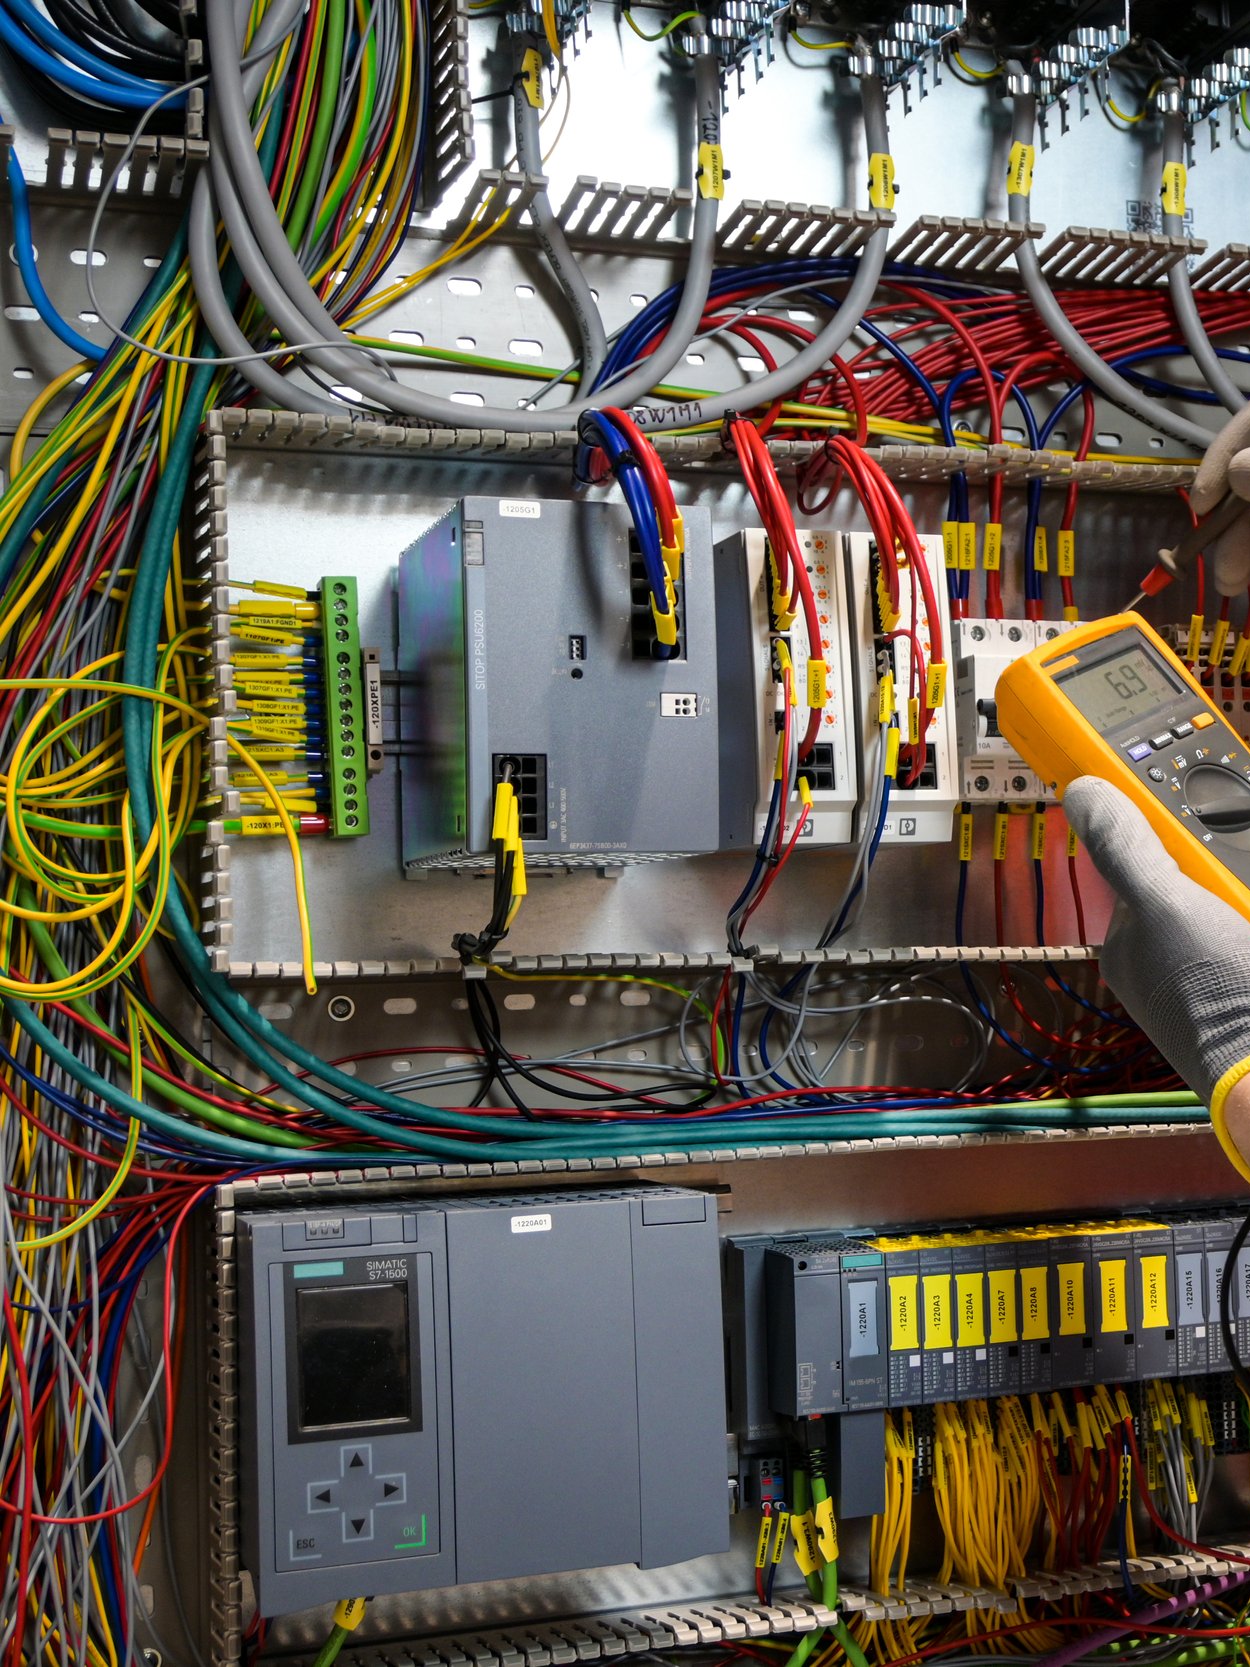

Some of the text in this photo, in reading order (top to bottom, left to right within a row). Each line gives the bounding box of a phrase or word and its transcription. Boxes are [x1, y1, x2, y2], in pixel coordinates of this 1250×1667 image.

[711, 149, 720, 192] -1207W1M1
[1015, 147, 1028, 189] -1307W1M1
[986, 532, 994, 563] 1205G1:+2
[475, 608, 486, 690] SITOP PSU6200
[371, 679, 380, 729] -120XPE1
[812, 669, 820, 703] 1205G1:+1
[931, 672, 942, 705] 1205G1:+1
[977, 742, 991, 750] 10A
[1176, 722, 1193, 733] RANGE
[1133, 745, 1148, 755] HOLD
[1202, 833, 1214, 842] OFF
[514, 1219, 548, 1228] -1220A01
[366, 1258, 408, 1271] SIMATIC
[368, 1269, 409, 1280] S7-1500
[966, 1292, 974, 1329] -1220A4
[998, 1288, 1006, 1325] -1220A7
[1029, 1285, 1038, 1323] -1220A8
[1066, 1278, 1075, 1320] -1220A10
[1108, 1276, 1116, 1317] -1220A11
[1149, 1271, 1158, 1313] -1220A12
[859, 1301, 867, 1338] -1220A1
[899, 1294, 908, 1332] -1220A2
[933, 1293, 941, 1331] -1220A3
[296, 1538, 315, 1549] ESC
[403, 1526, 417, 1537] OK
[802, 1521, 816, 1563] -1290W3.1
